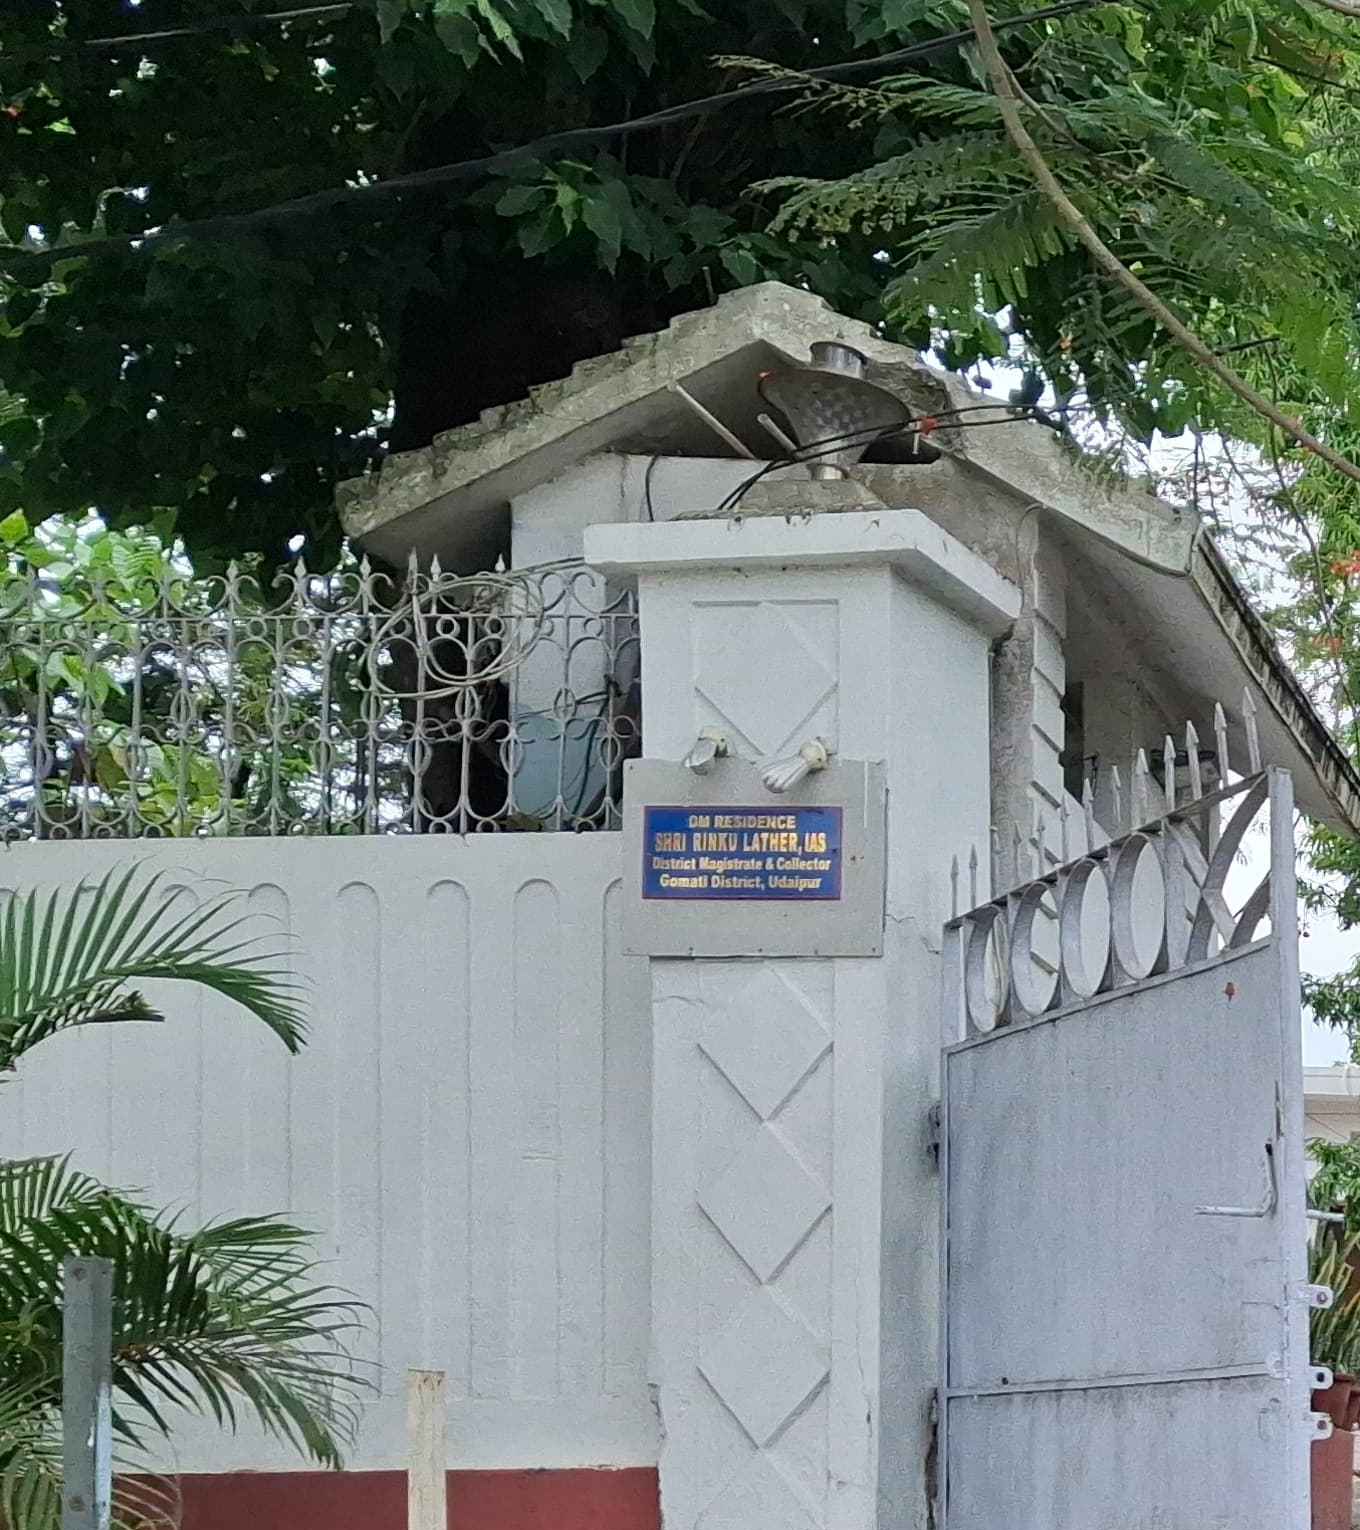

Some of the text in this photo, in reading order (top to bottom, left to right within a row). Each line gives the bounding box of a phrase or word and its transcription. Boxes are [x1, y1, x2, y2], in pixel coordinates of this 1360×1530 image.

[688, 815, 796, 829] DM RESIDENCE
[655, 832, 827, 855] SHRI RINKU LATHER, IAS
[652, 857, 832, 873] District Magistrate & Collector
[660, 874, 822, 891] Gomati District, Udaipur
